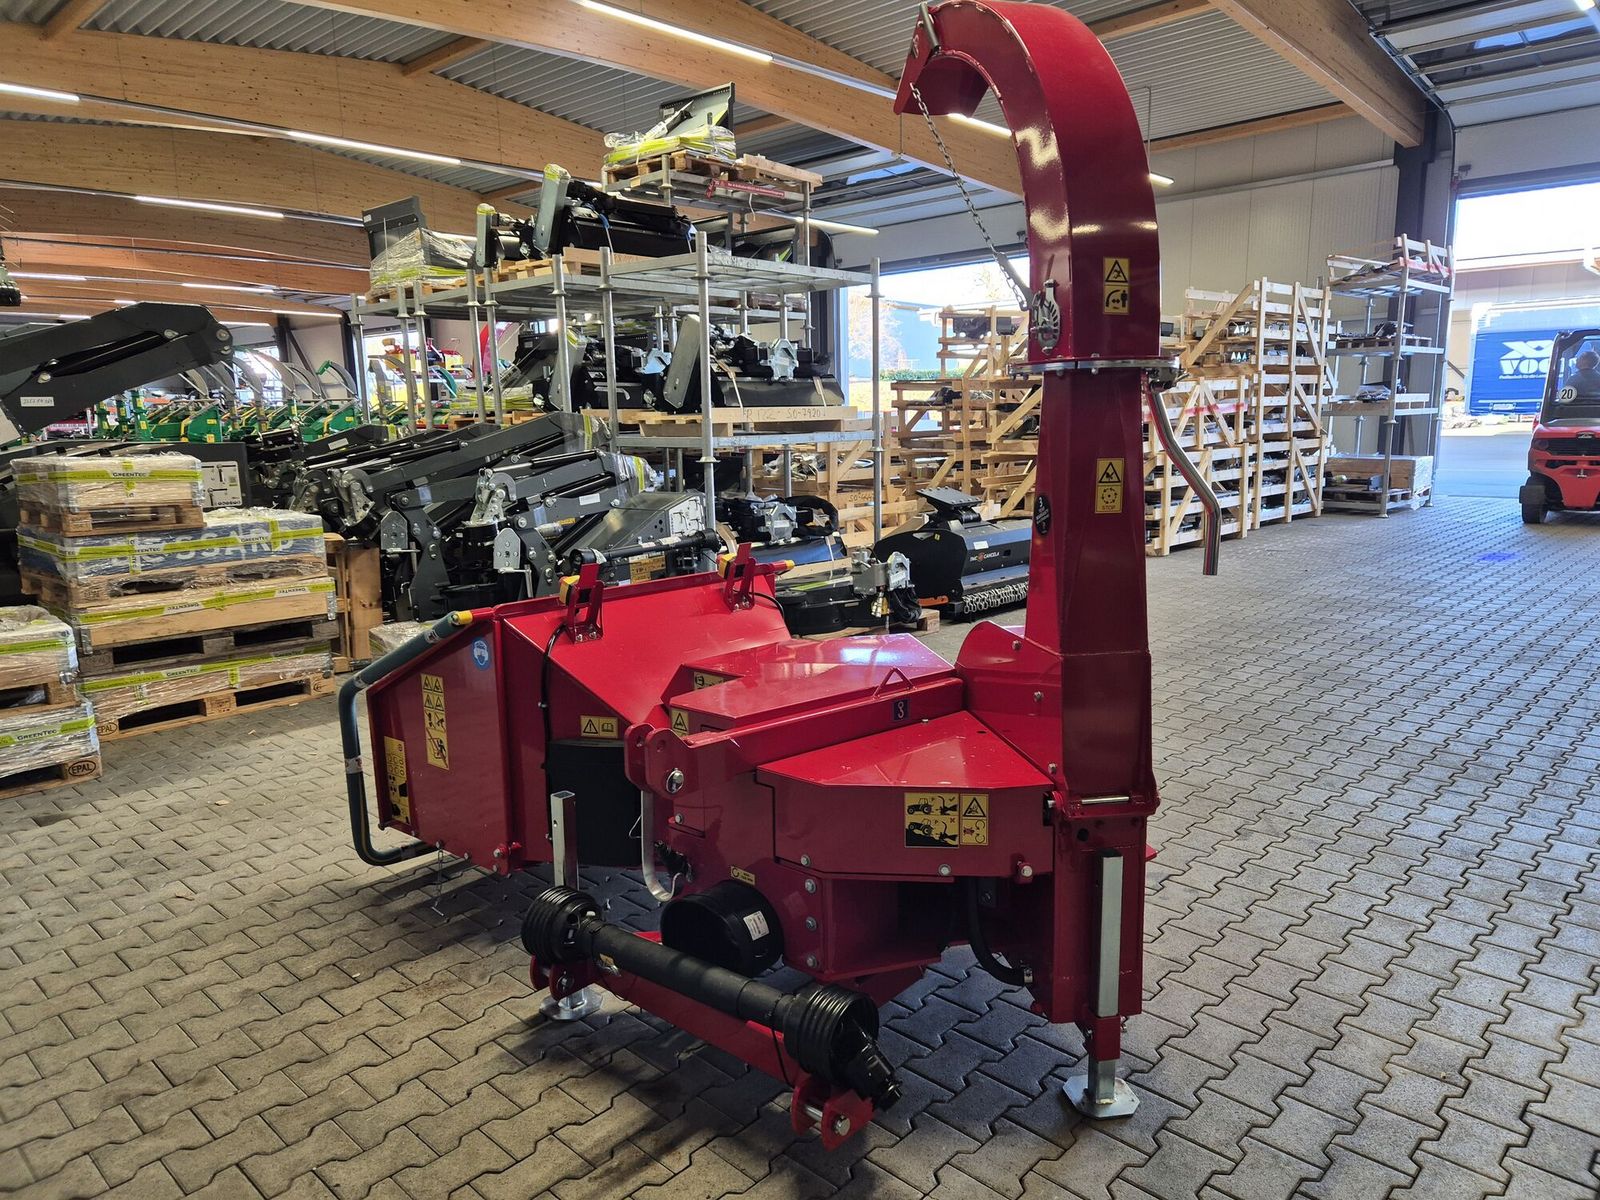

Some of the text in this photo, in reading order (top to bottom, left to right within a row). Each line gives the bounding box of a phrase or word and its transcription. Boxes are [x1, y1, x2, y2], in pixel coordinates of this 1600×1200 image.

[1561, 388, 1573, 400] 20
[97, 724, 114, 734] EPAL
[71, 762, 92, 774] EPAL
